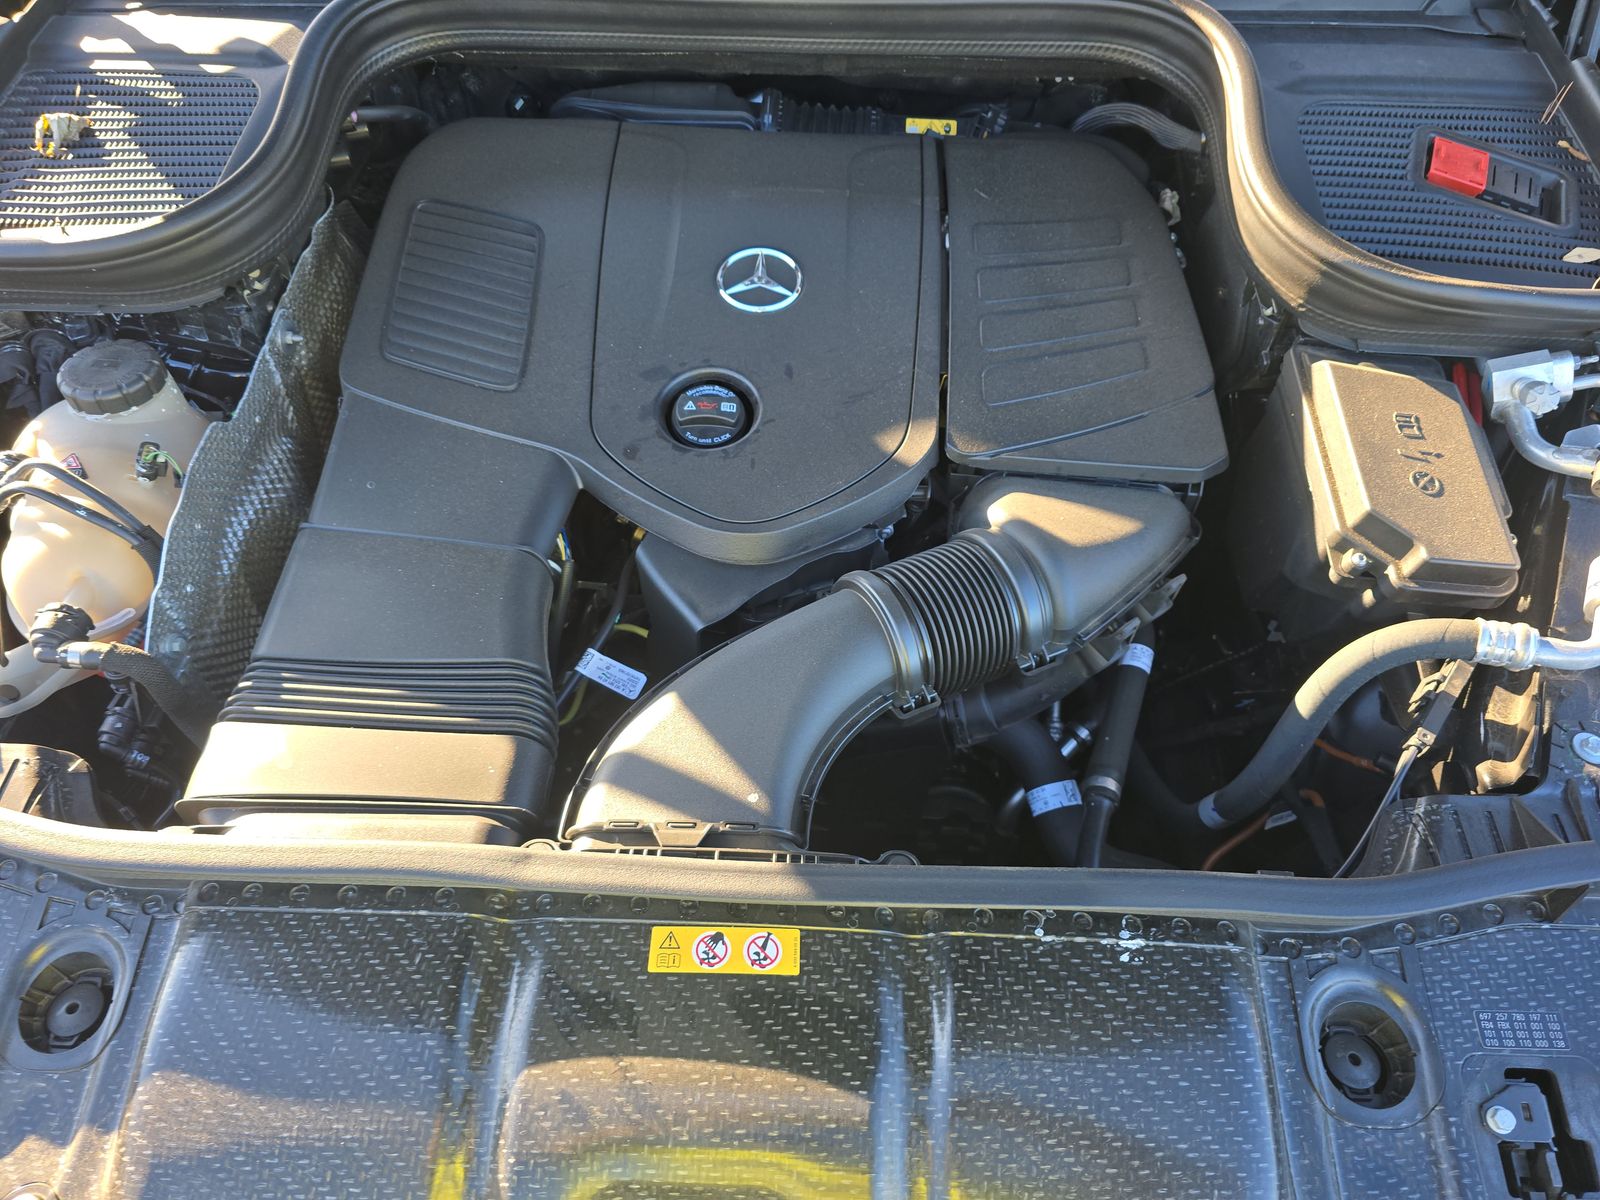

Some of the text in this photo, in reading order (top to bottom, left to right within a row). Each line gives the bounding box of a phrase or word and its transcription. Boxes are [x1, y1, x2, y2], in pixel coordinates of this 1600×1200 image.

[685, 432, 698, 441] Turn
[714, 433, 731, 442] CLICK
[1479, 1012, 1491, 1020] 697
[1495, 1012, 1508, 1020] 257
[1512, 1013, 1525, 1021] 780
[1529, 1013, 1541, 1021] 197
[1530, 1022, 1543, 1030] 001
[1502, 1039, 1515, 1047] 100
